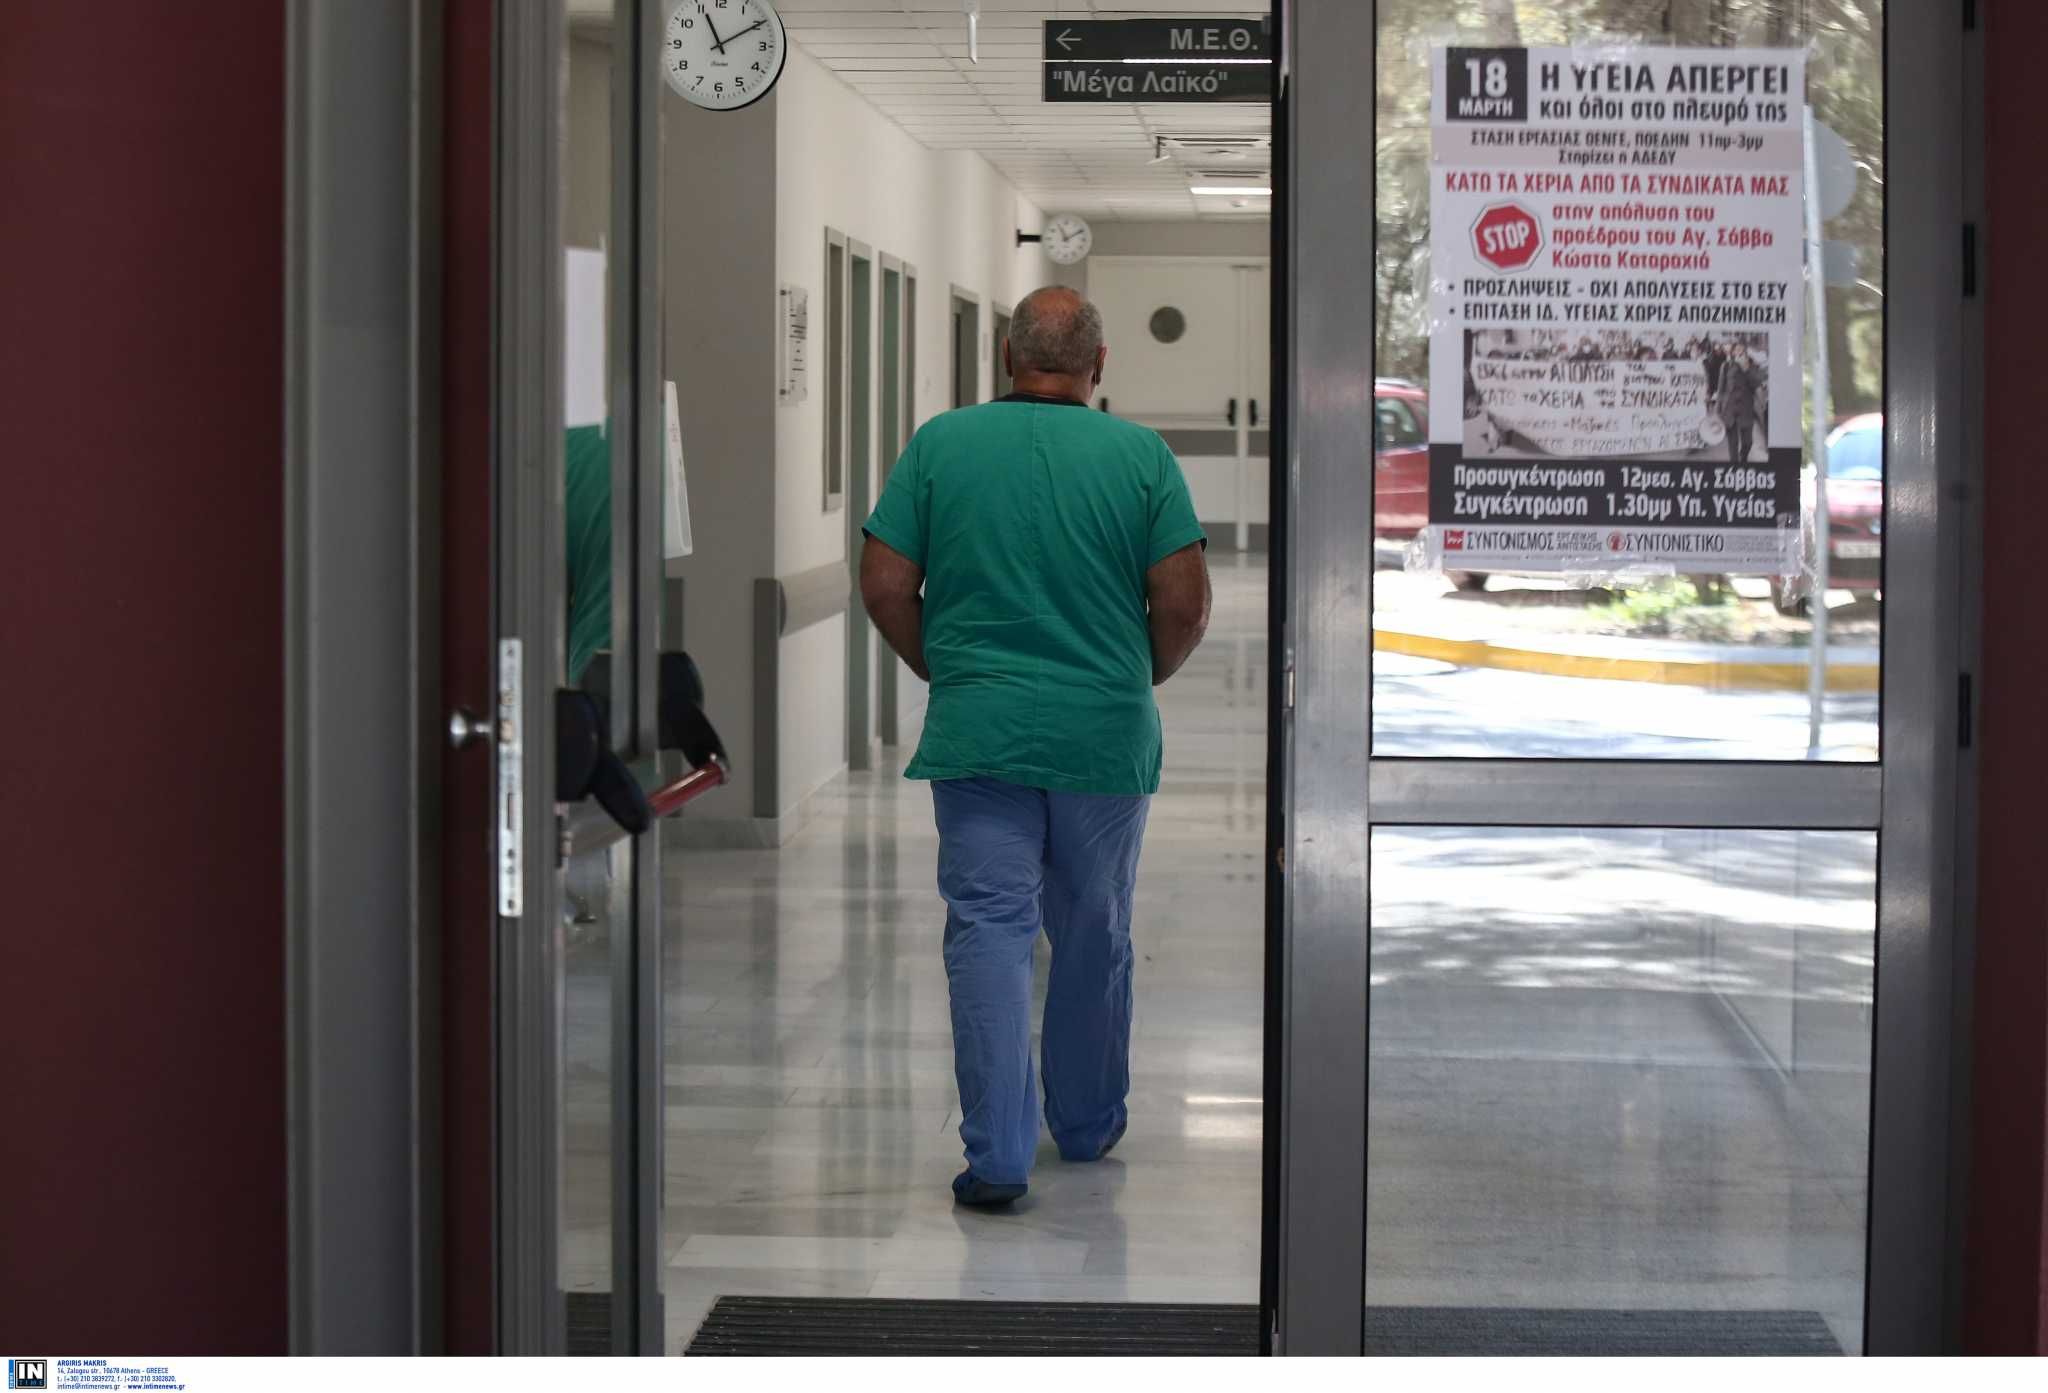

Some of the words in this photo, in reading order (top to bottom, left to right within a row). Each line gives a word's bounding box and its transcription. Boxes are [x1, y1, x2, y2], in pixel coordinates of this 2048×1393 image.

[697, 4, 705, 14] 11
[681, 19, 693, 29] 10
[673, 39, 682, 49] 9
[759, 42, 767, 51] 3
[1170, 28, 1258, 51] Μ.Ε.Θ.
[679, 60, 688, 70] 8
[751, 62, 760, 71] 4
[696, 76, 704, 86] 7
[714, 82, 723, 92] 6
[735, 77, 744, 87] 5
[1053, 70, 1134, 98] "Μέγα
[1141, 69, 1228, 93] Λαϊκό"
[1464, 58, 1508, 98] 18
[1541, 63, 1560, 92] Η
[1570, 63, 1655, 93] ΥΓΕΙΑ
[1666, 64, 1789, 94] ΑΠΕΡΓΕΙ
[1458, 98, 1513, 117] ΜΑΡΤΗ
[1540, 100, 1571, 119] και
[1579, 95, 1624, 119] όλοι
[1631, 101, 1666, 120] στο
[1673, 97, 1749, 126] πλευρό
[1756, 101, 1788, 122] της
[1470, 131, 1514, 146] ΣΤΑΣΗ
[1518, 131, 1581, 147] ΕΡΓΑΣΙΑΣ
[1635, 132, 1690, 148] ΠΟΕΔΗΝ
[1558, 150, 1614, 167] Στηρίζει
[1619, 153, 1627, 165] η
[1631, 151, 1676, 166] ΑΔΕΔΥ
[1446, 173, 1491, 193] ΚΑΤΩ
[1498, 174, 1518, 193] ΤΑ
[1524, 174, 1574, 193] ΧΕΡΙΑ
[1580, 174, 1615, 194] ΑΠΟ
[1621, 174, 1641, 194] ΤΑ
[1647, 175, 1745, 196] ΣΥΝΔΙΚΑΤΑ
[1751, 176, 1790, 197] ΜΑΣ
[1553, 204, 1594, 221] στην
[1600, 201, 1680, 222] απόλυση
[1685, 207, 1715, 222] του
[1483, 219, 1530, 254] STOP
[1553, 226, 1640, 247] προέδρου
[1646, 230, 1676, 246] του
[1682, 228, 1711, 249] Αγ.
[1717, 228, 1774, 249] Σάββα
[1553, 249, 1612, 269] Κώστα
[1617, 250, 1710, 273] Καταραχιά
[1464, 279, 1571, 297] ΠΡΟΣΛΗΨΕΙΣ
[1591, 281, 1618, 298] ΟΧΙ
[1624, 281, 1715, 299] ΑΠΟΛΥΣΕΙΣ
[1721, 282, 1753, 300] ΣΤΟ
[1758, 283, 1788, 300] ΕΣΥ
[1464, 304, 1531, 321] ΕΠΙΤΑΞΗ
[1537, 304, 1559, 321] ΙΔ.
[1565, 304, 1619, 322] ΥΓΕΙΑΣ
[1624, 305, 1673, 323] ΧΩΡΙΣ
[1678, 305, 1787, 324] ΑΠΟΖΗΜΙΩΣΗ
[1454, 464, 1605, 490] Προσυγκέντρωση
[1621, 466, 1675, 490] 12μεσ.
[1680, 467, 1708, 492] Αγ.
[1714, 466, 1776, 492] Σάββας
[1454, 490, 1588, 520] Συγκέντρωση
[1606, 493, 1672, 521] 1.30μμ
[1677, 494, 1706, 517] Υπ.
[1712, 494, 1776, 522] Υγείας
[1466, 531, 1554, 550] ΣΥΝΤΟΝΙΣΜΟΣ
[1625, 534, 1724, 552] ΣΥΝΤΟΝΙΣΤΙΚΟ
